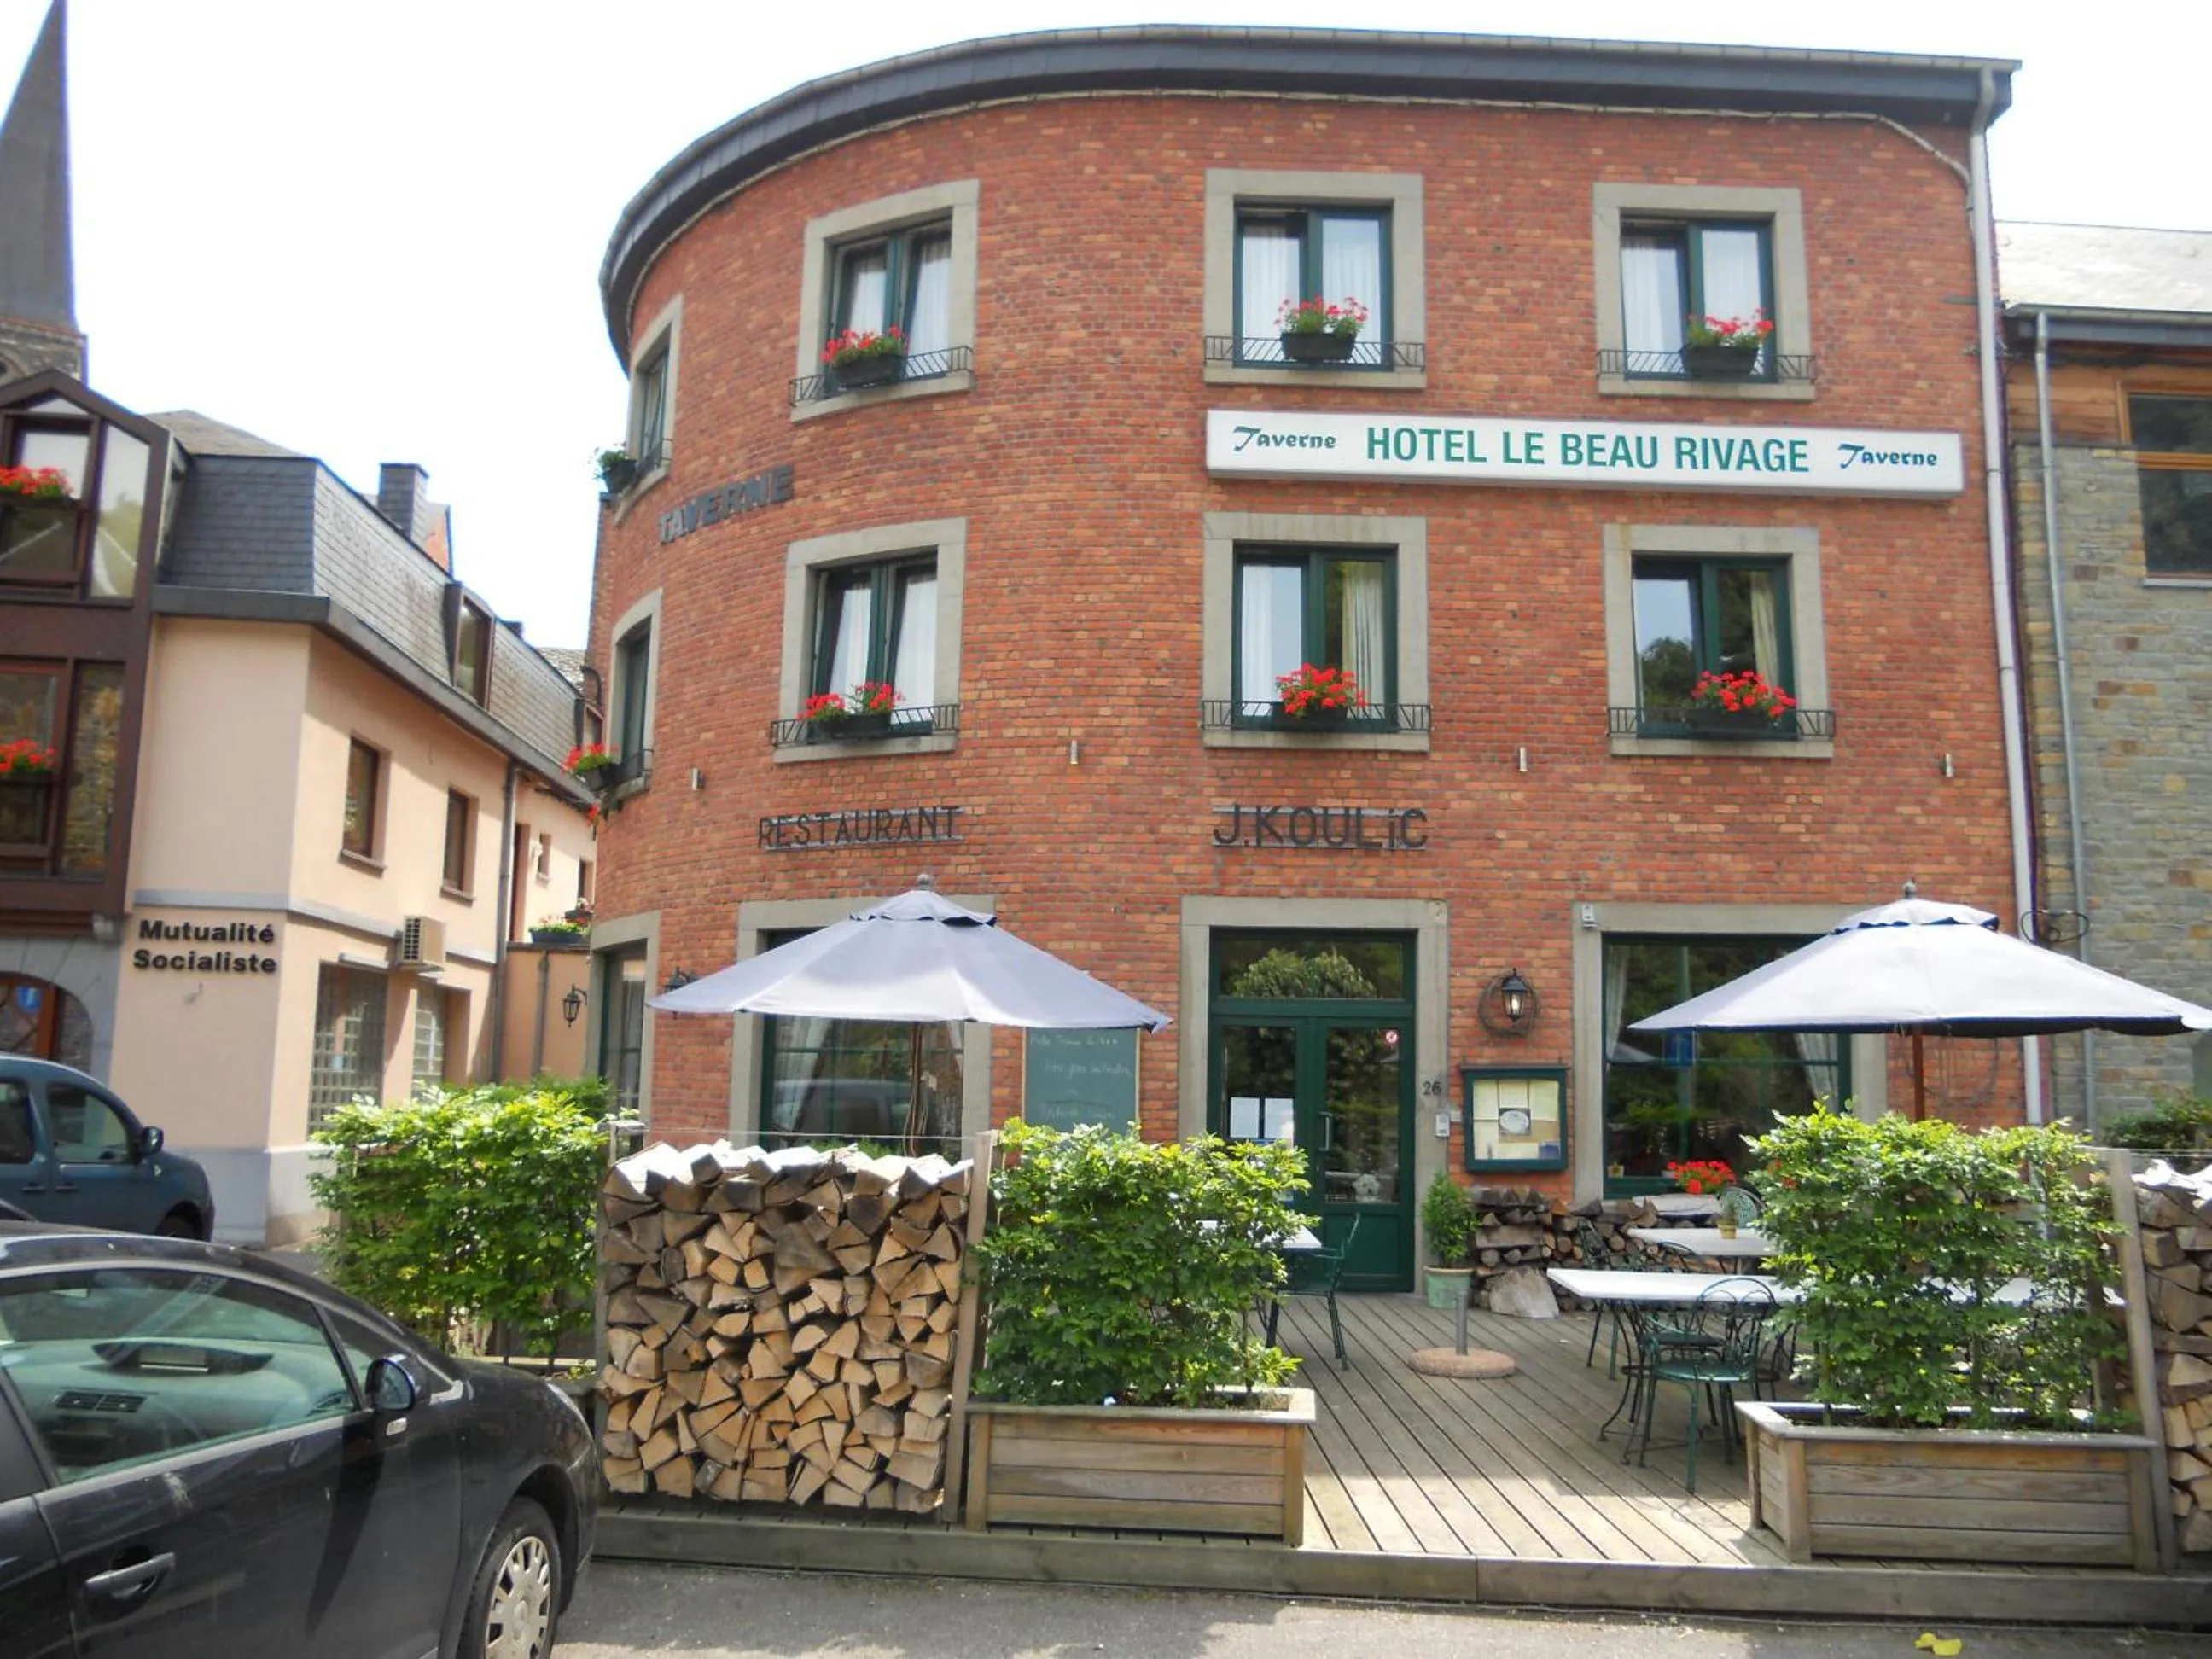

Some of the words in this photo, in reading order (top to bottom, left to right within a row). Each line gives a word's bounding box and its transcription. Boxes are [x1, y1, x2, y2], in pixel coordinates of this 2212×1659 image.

[1232, 426, 1337, 452] Taverne
[1366, 427, 1487, 463] HOTEL
[1502, 431, 1545, 465] LE
[1560, 433, 1659, 469] BEAU
[1674, 436, 1810, 473] RIVAGE
[1837, 443, 1938, 469] Taverne
[659, 463, 795, 545] TAVERNE
[758, 805, 960, 849] RESTAURANT
[138, 919, 275, 944] Mutualité
[132, 948, 277, 974] Socialiste
[1422, 1080, 1442, 1096] 26
